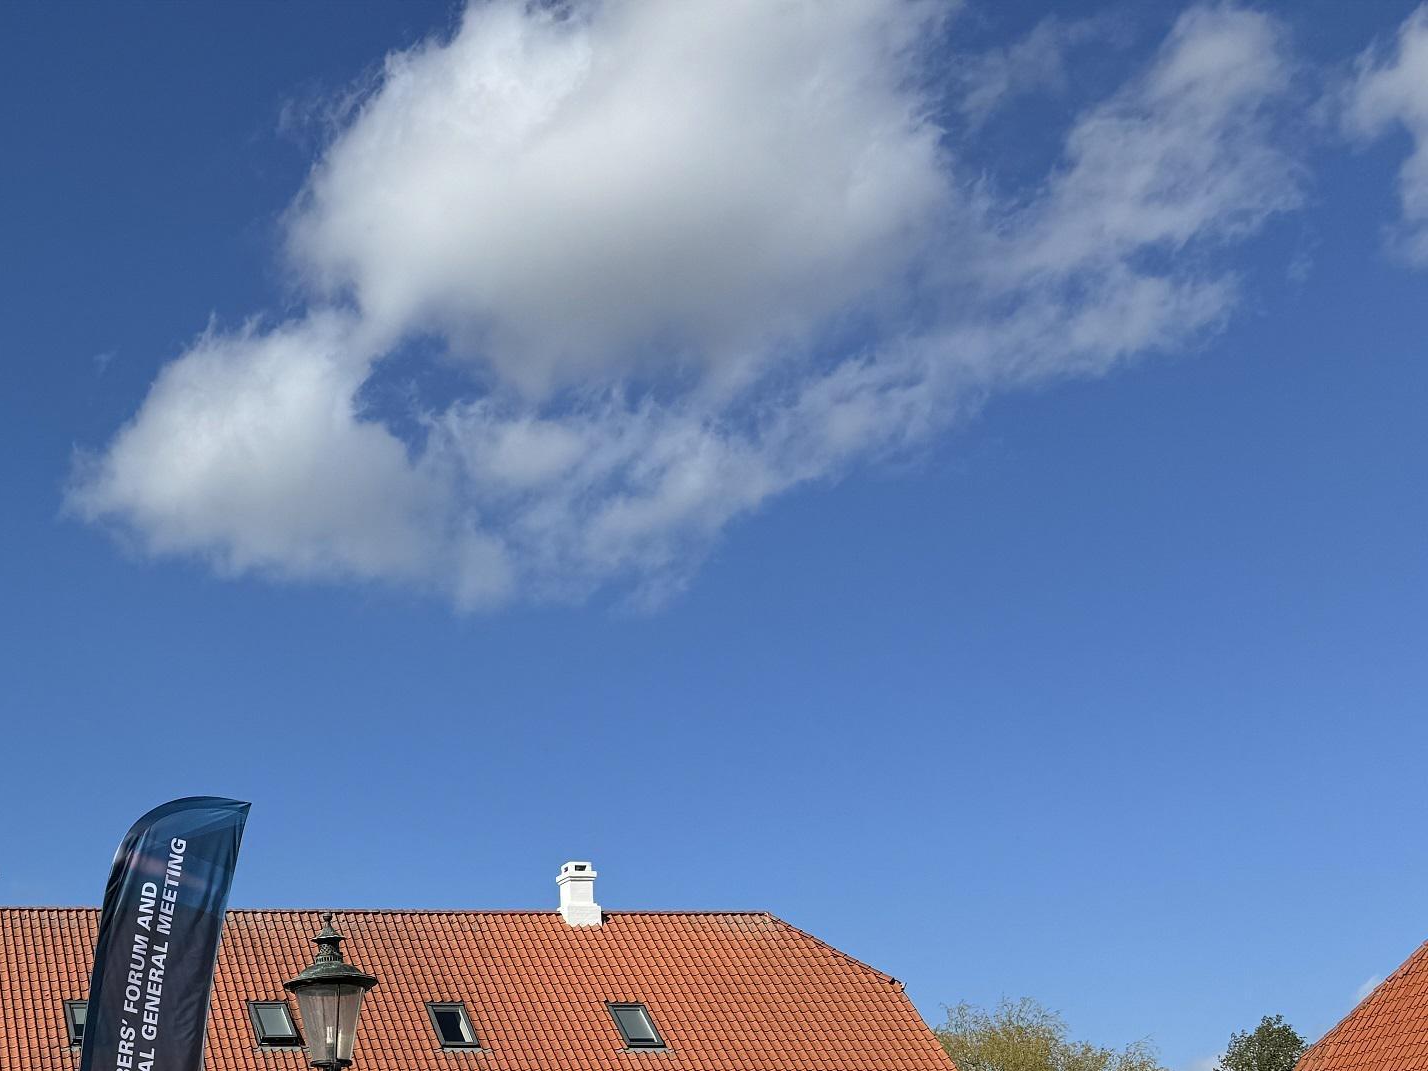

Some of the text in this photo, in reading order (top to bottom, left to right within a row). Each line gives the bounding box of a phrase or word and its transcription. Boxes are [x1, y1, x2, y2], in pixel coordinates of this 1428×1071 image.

[136, 881, 158, 932] AND
[141, 941, 169, 1041] GENERAL
[156, 837, 187, 936] MEETING
[123, 934, 150, 1014] FORUM
